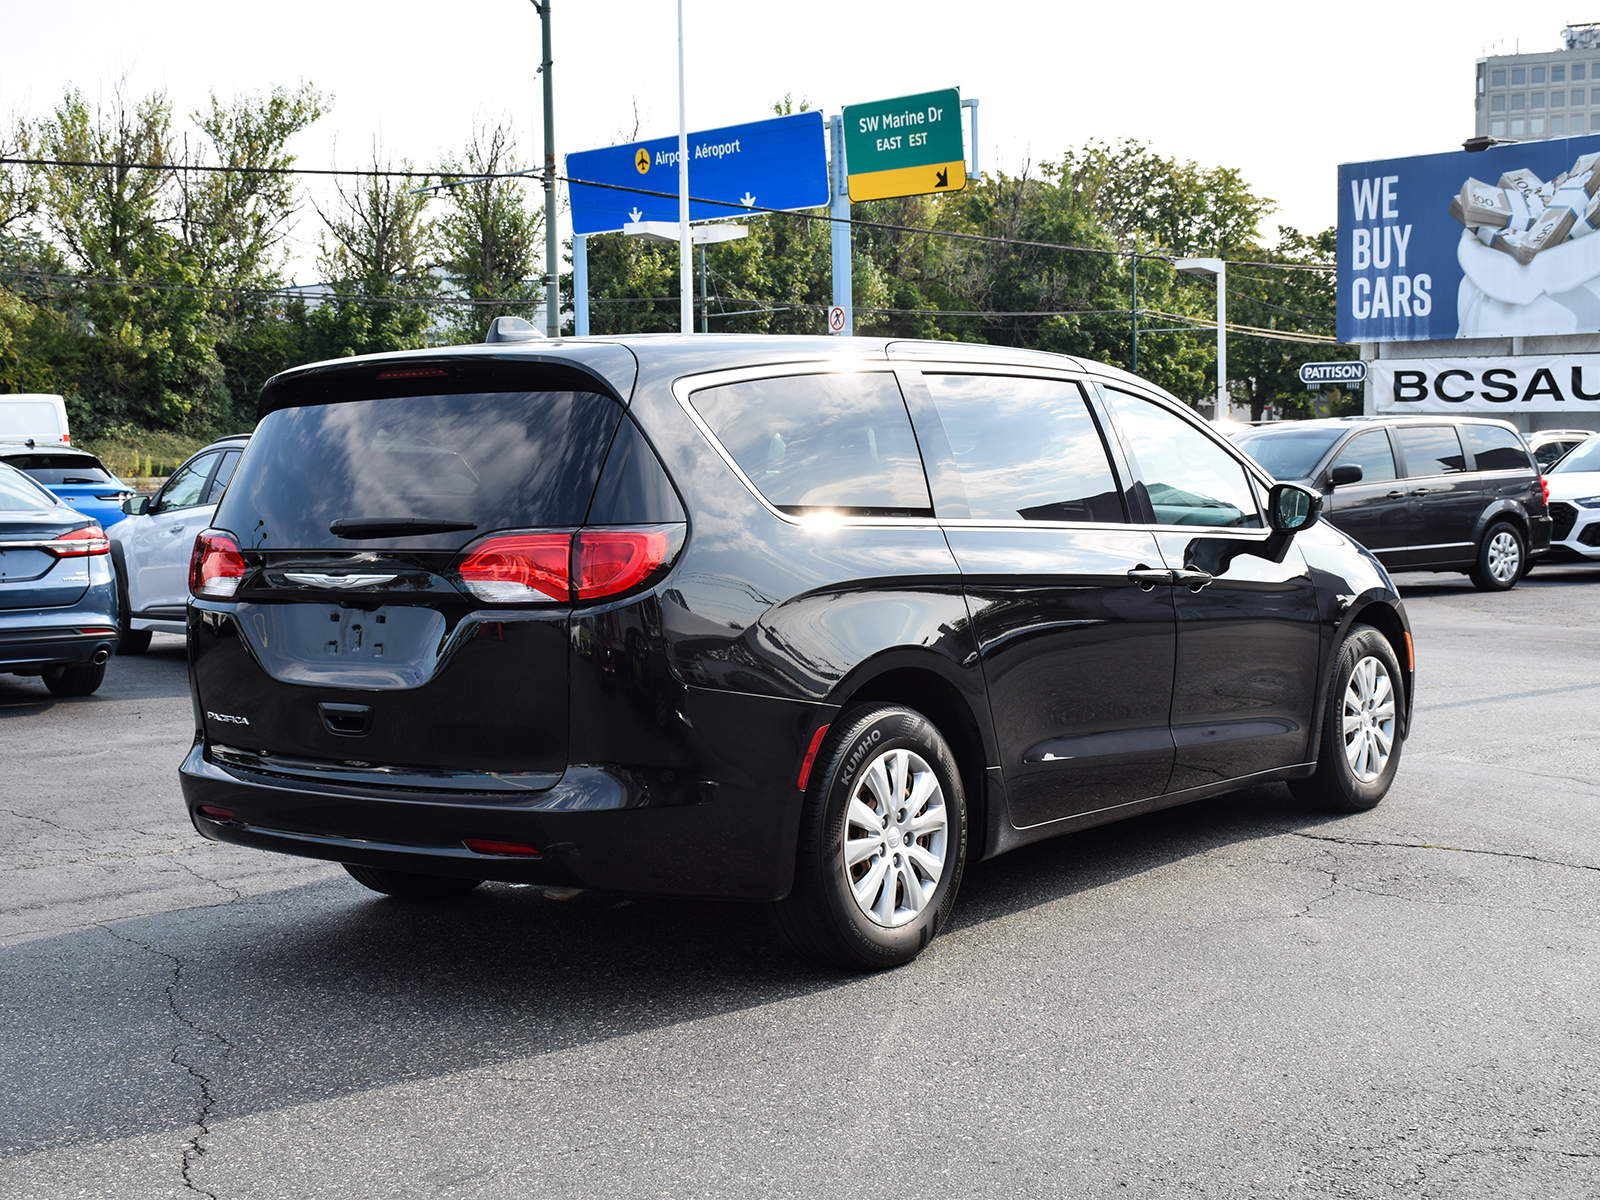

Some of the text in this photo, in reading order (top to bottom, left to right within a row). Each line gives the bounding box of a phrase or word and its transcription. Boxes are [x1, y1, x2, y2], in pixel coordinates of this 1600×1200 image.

[859, 107, 943, 133] SW Marine Dr
[655, 139, 741, 167] Airpot Aéroport
[876, 132, 928, 151] EAST EST
[1351, 175, 1399, 221] WE
[1472, 194, 1494, 207] 100
[1533, 223, 1554, 243] 100
[1352, 224, 1412, 270] BUY
[1352, 273, 1432, 320] CARS
[1304, 365, 1362, 379] PATTISON
[1393, 366, 1600, 403] BCSAU
[207, 711, 249, 725] PACIFICA
[840, 729, 881, 786] KUMHO
